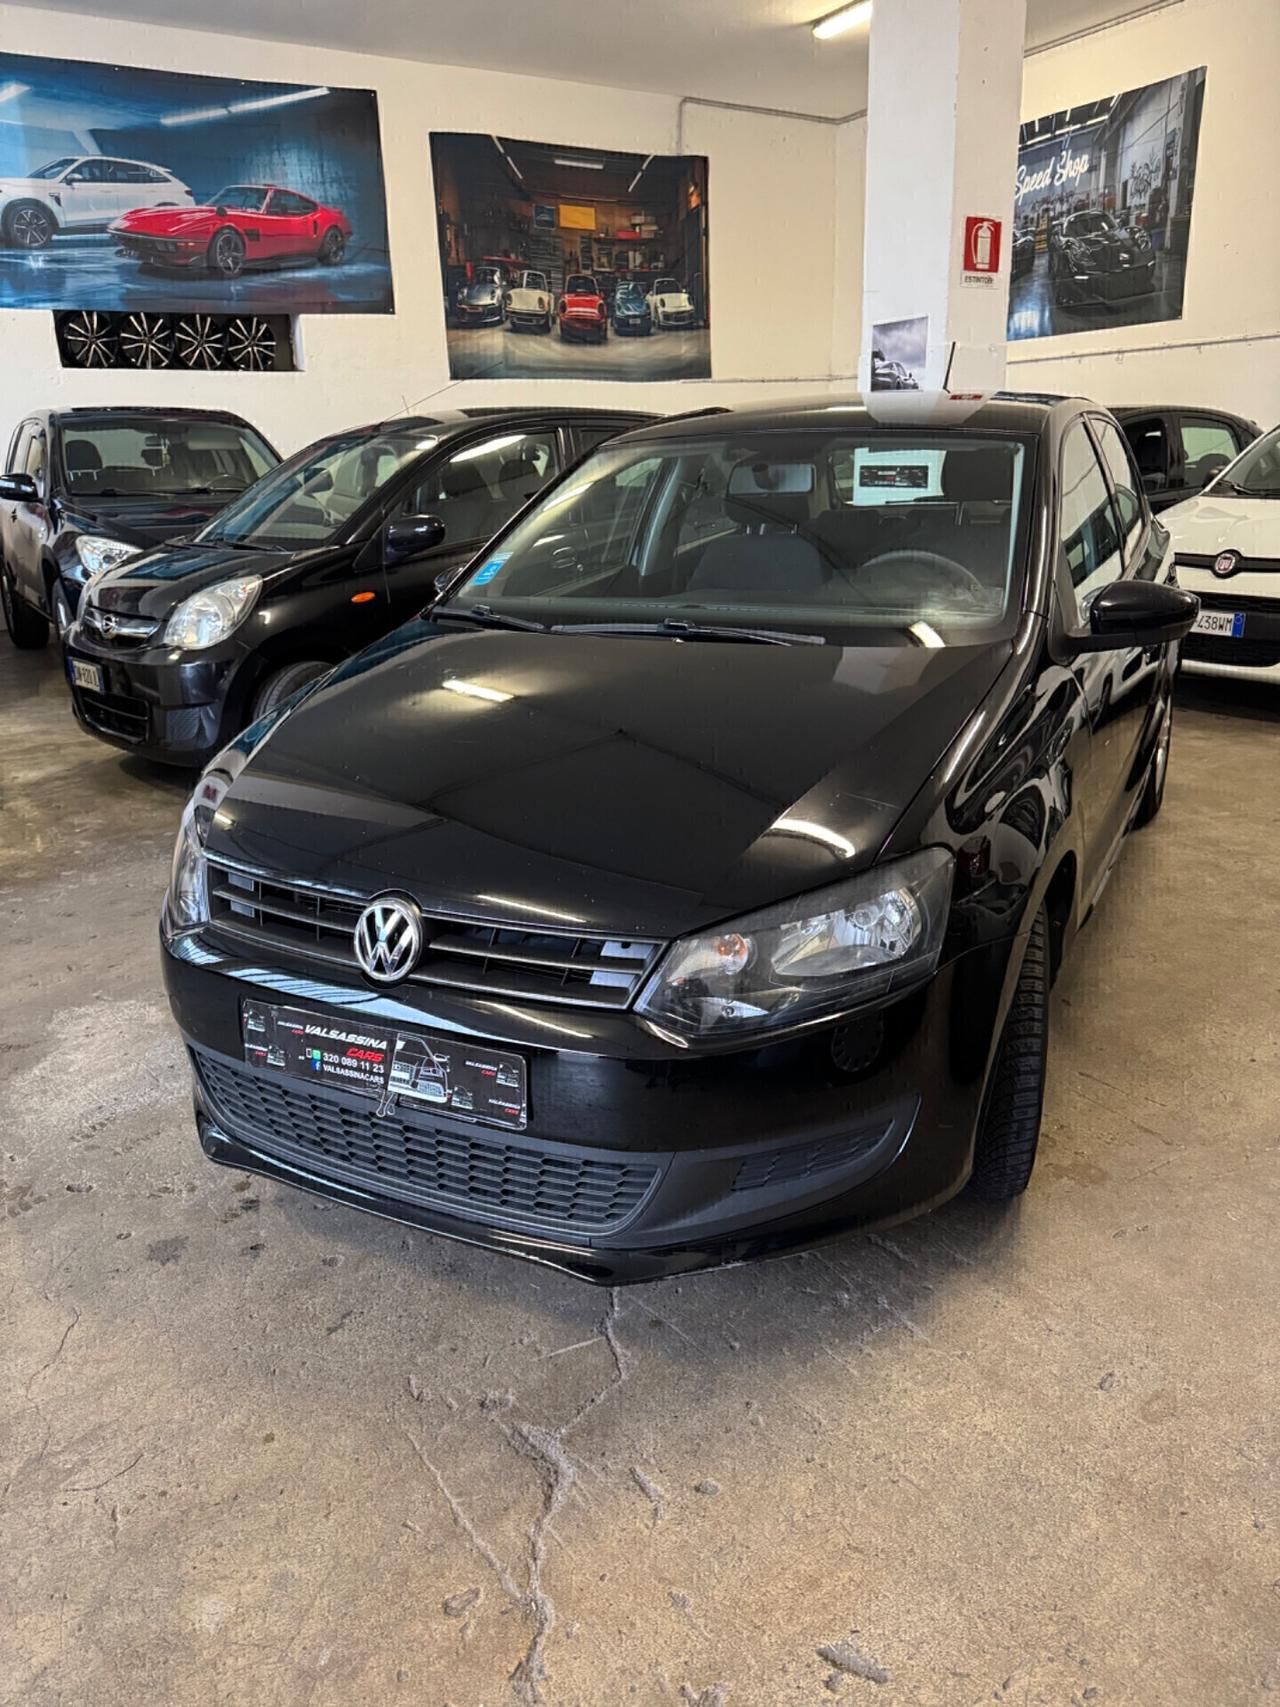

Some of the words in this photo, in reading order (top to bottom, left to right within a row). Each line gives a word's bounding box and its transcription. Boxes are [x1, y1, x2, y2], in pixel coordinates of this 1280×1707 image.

[1014, 156, 1055, 206] Speed
[1054, 150, 1090, 187] Shop
[304, 1024, 388, 1050] VALSASSINA
[322, 1052, 340, 1064] 320
[360, 1060, 370, 1071] 11
[372, 1063, 385, 1074] 23
[346, 1046, 384, 1062] CARS
[322, 1063, 385, 1085] VALSASSINACARS
